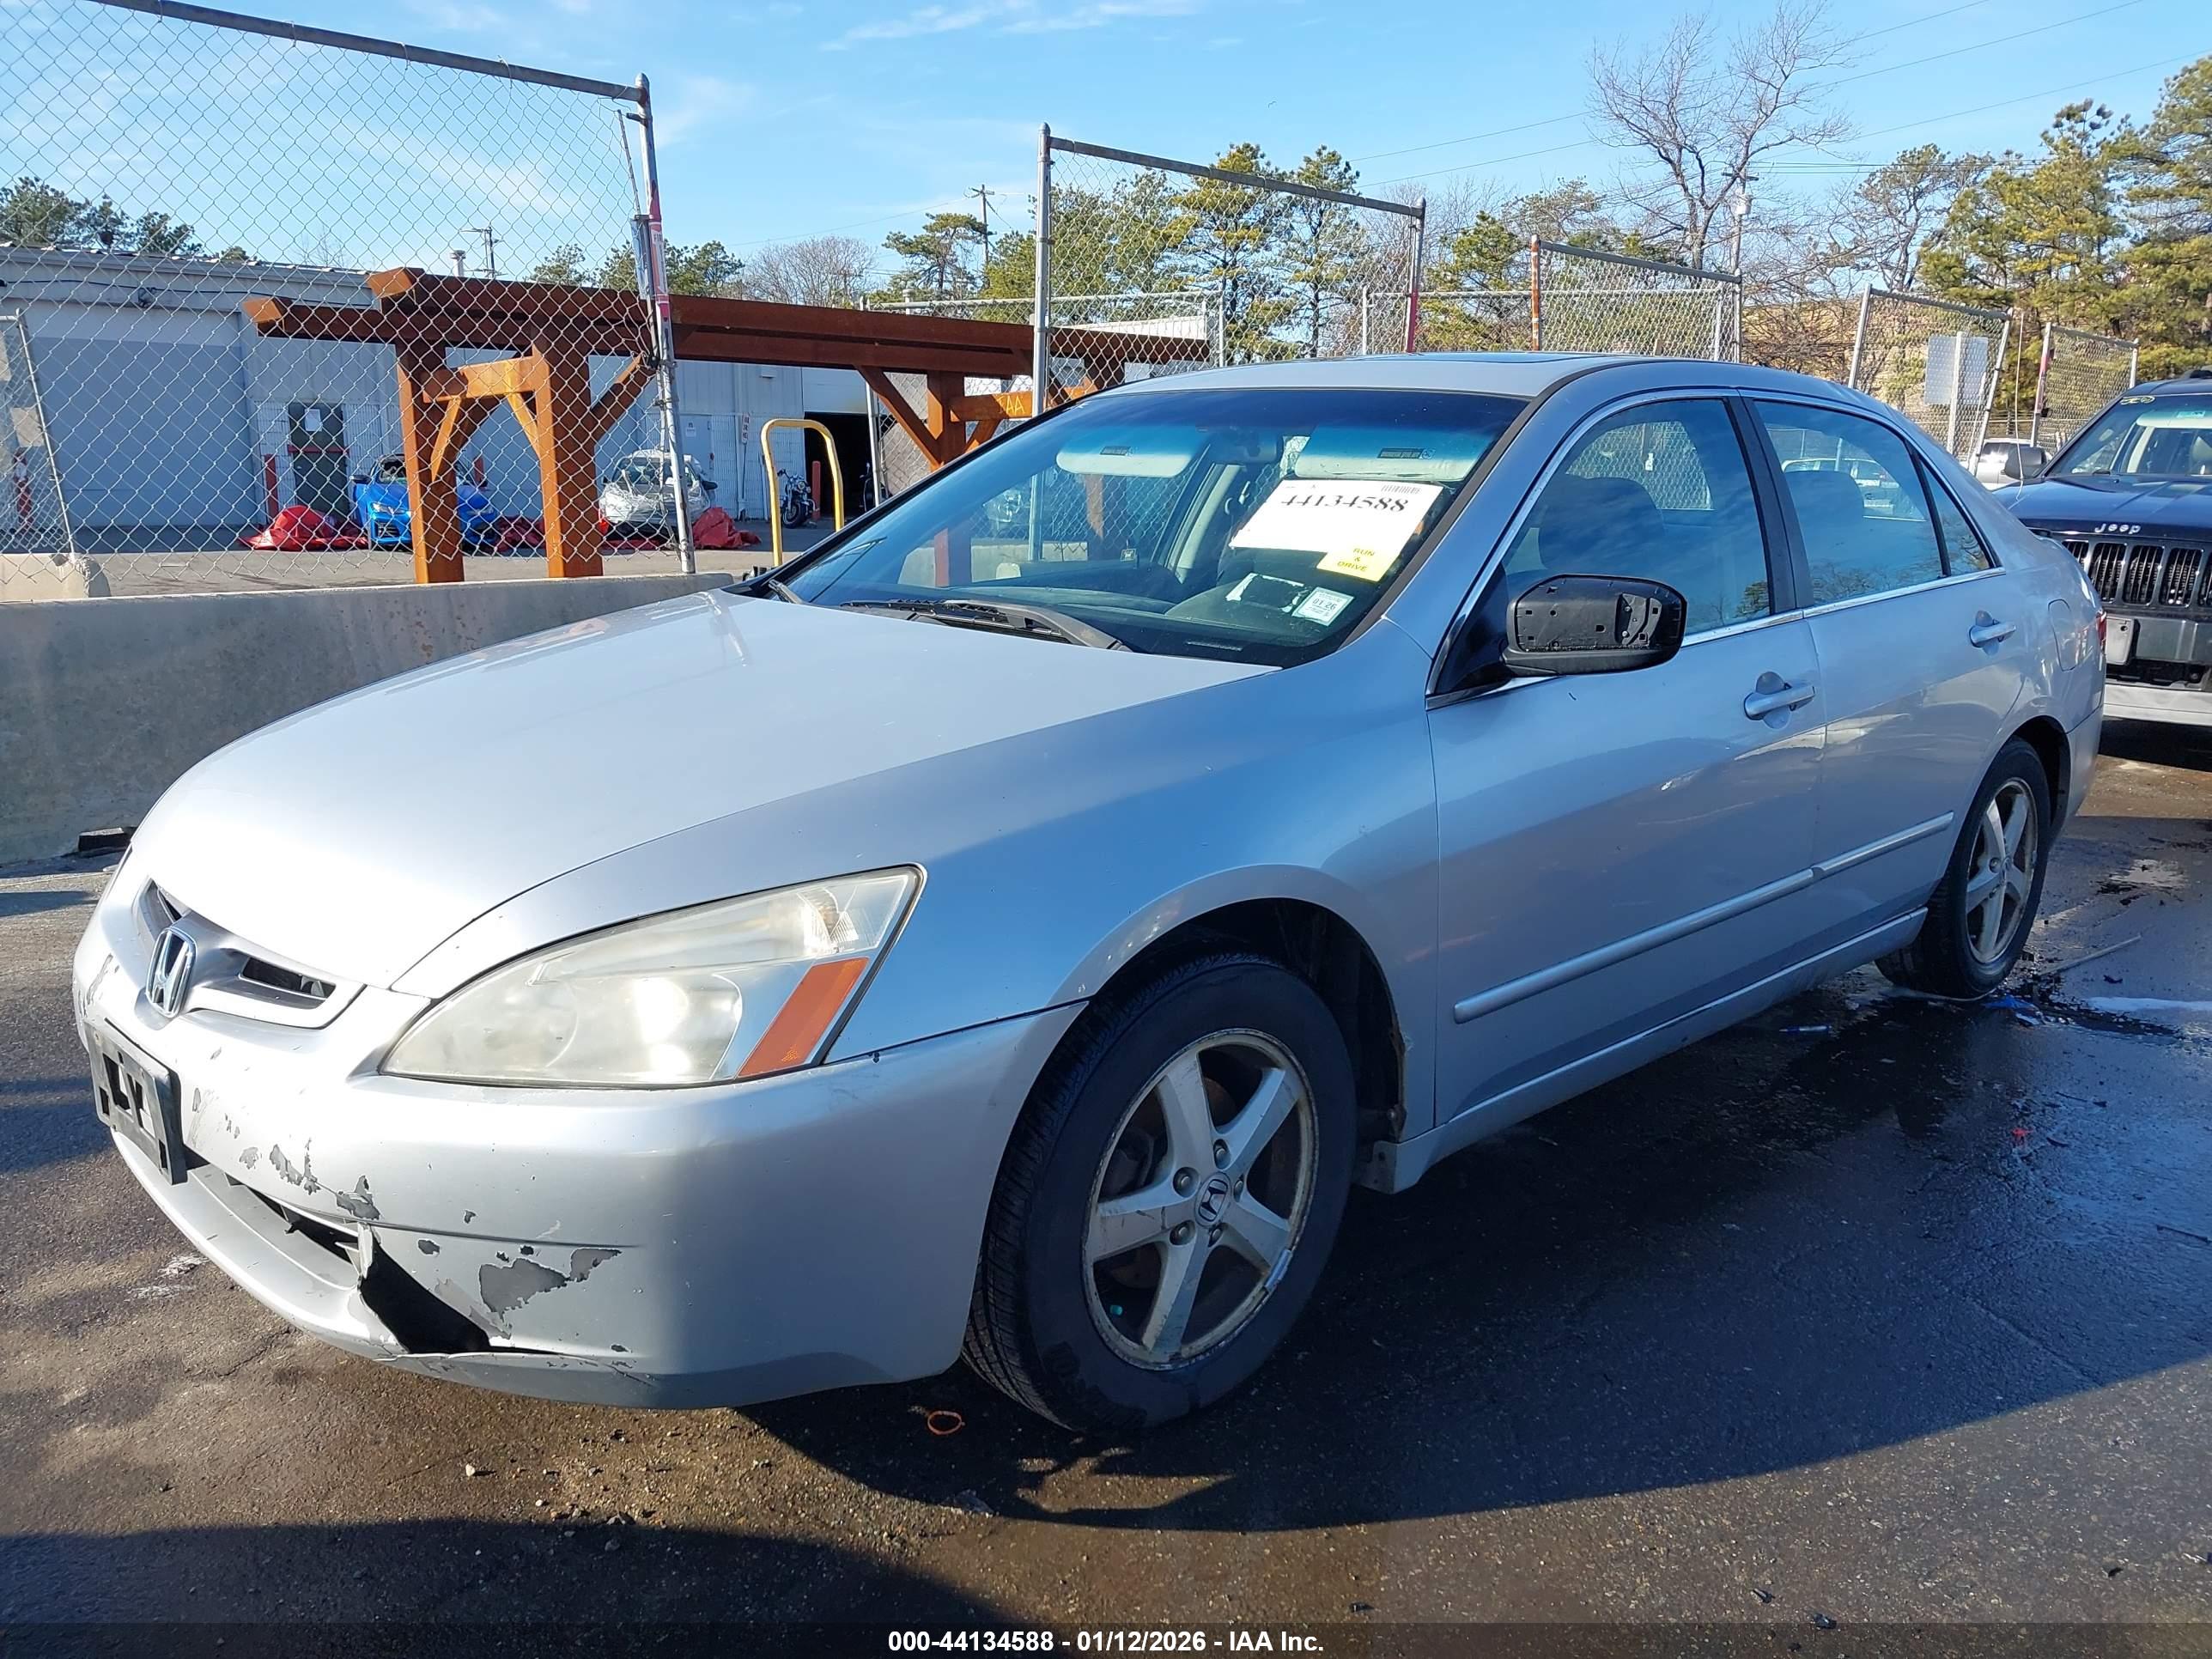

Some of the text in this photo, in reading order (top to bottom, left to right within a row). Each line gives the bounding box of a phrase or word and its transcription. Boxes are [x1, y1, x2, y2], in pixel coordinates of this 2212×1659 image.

[1281, 495, 1408, 512] 44134588
[2094, 523, 2142, 535] Jeep
[1337, 561, 1368, 572] DRIVE
